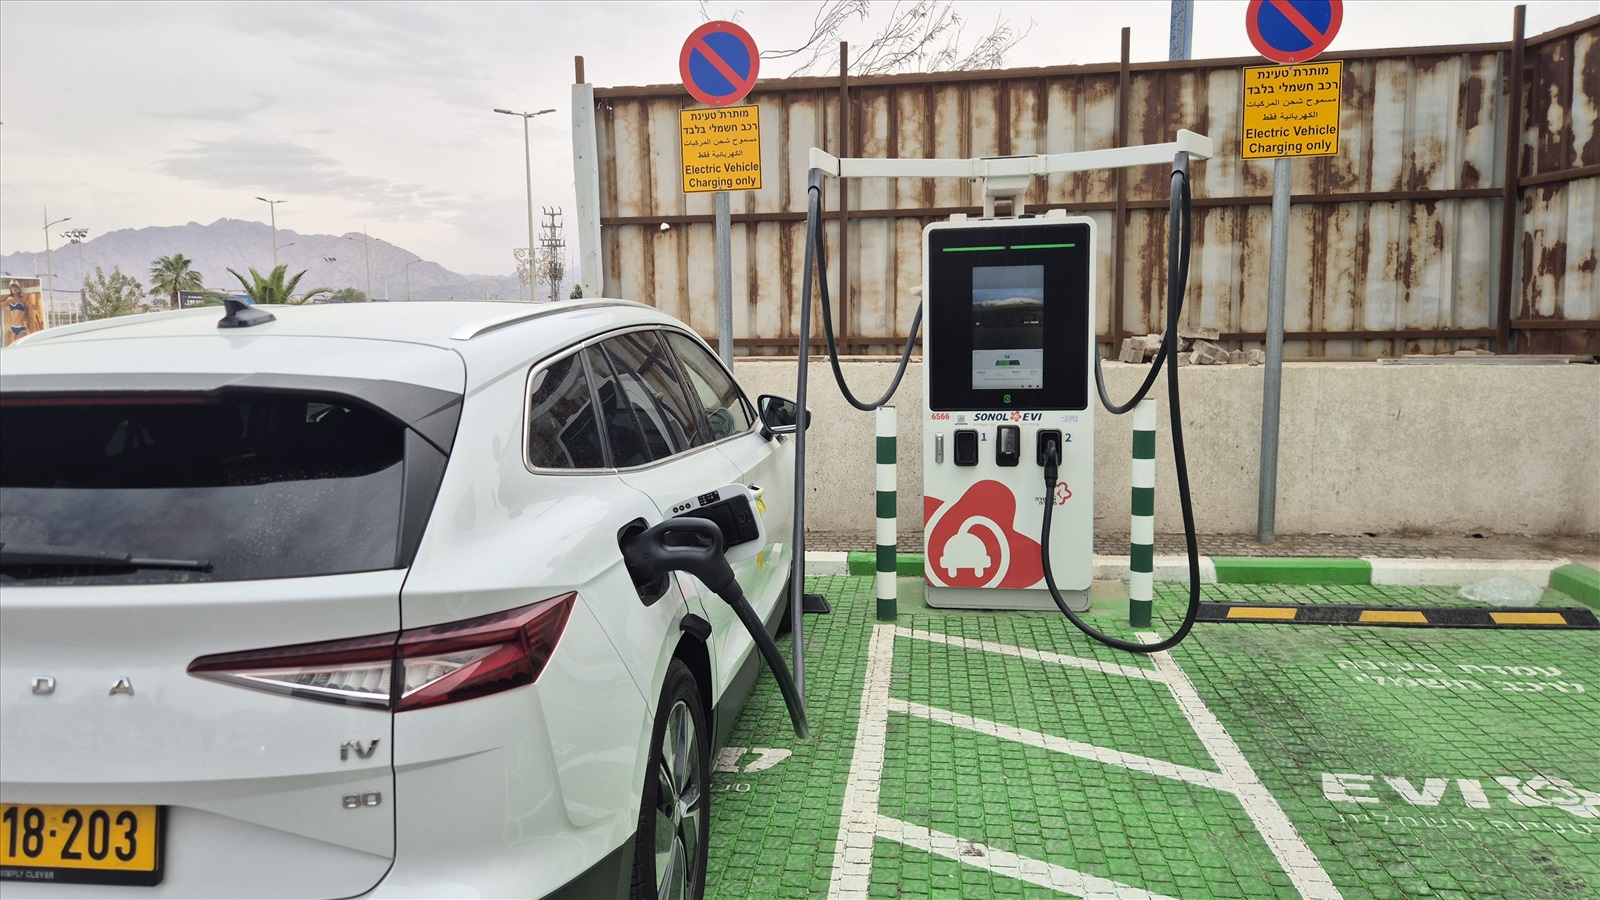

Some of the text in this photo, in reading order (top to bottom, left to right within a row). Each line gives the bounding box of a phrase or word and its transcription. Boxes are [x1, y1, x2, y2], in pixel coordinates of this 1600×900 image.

[1257, 66, 1329, 79] מותרת טעינת
[1247, 81, 1338, 94] רכב חשמלי בלבד
[1283, 98, 1303, 106] شحن
[1306, 98, 1336, 106] مسموح
[691, 110, 749, 121] מותרת טעינת
[1262, 112, 1277, 121] فقط
[683, 123, 758, 134] רכב חשמלי בלבד
[1246, 124, 1336, 139] Electric Vehicle
[1249, 139, 1332, 155] Charging only
[685, 162, 759, 175] Electric Vehicle
[689, 175, 757, 189] Charging only
[931, 412, 950, 420] 6566
[973, 412, 1042, 422] SONOL EVI
[981, 433, 987, 442] 1
[1065, 433, 1072, 442] 2
[1321, 773, 1491, 809] EVI
[342, 790, 382, 809] 80
[25, 870, 55, 879] CLEVER
